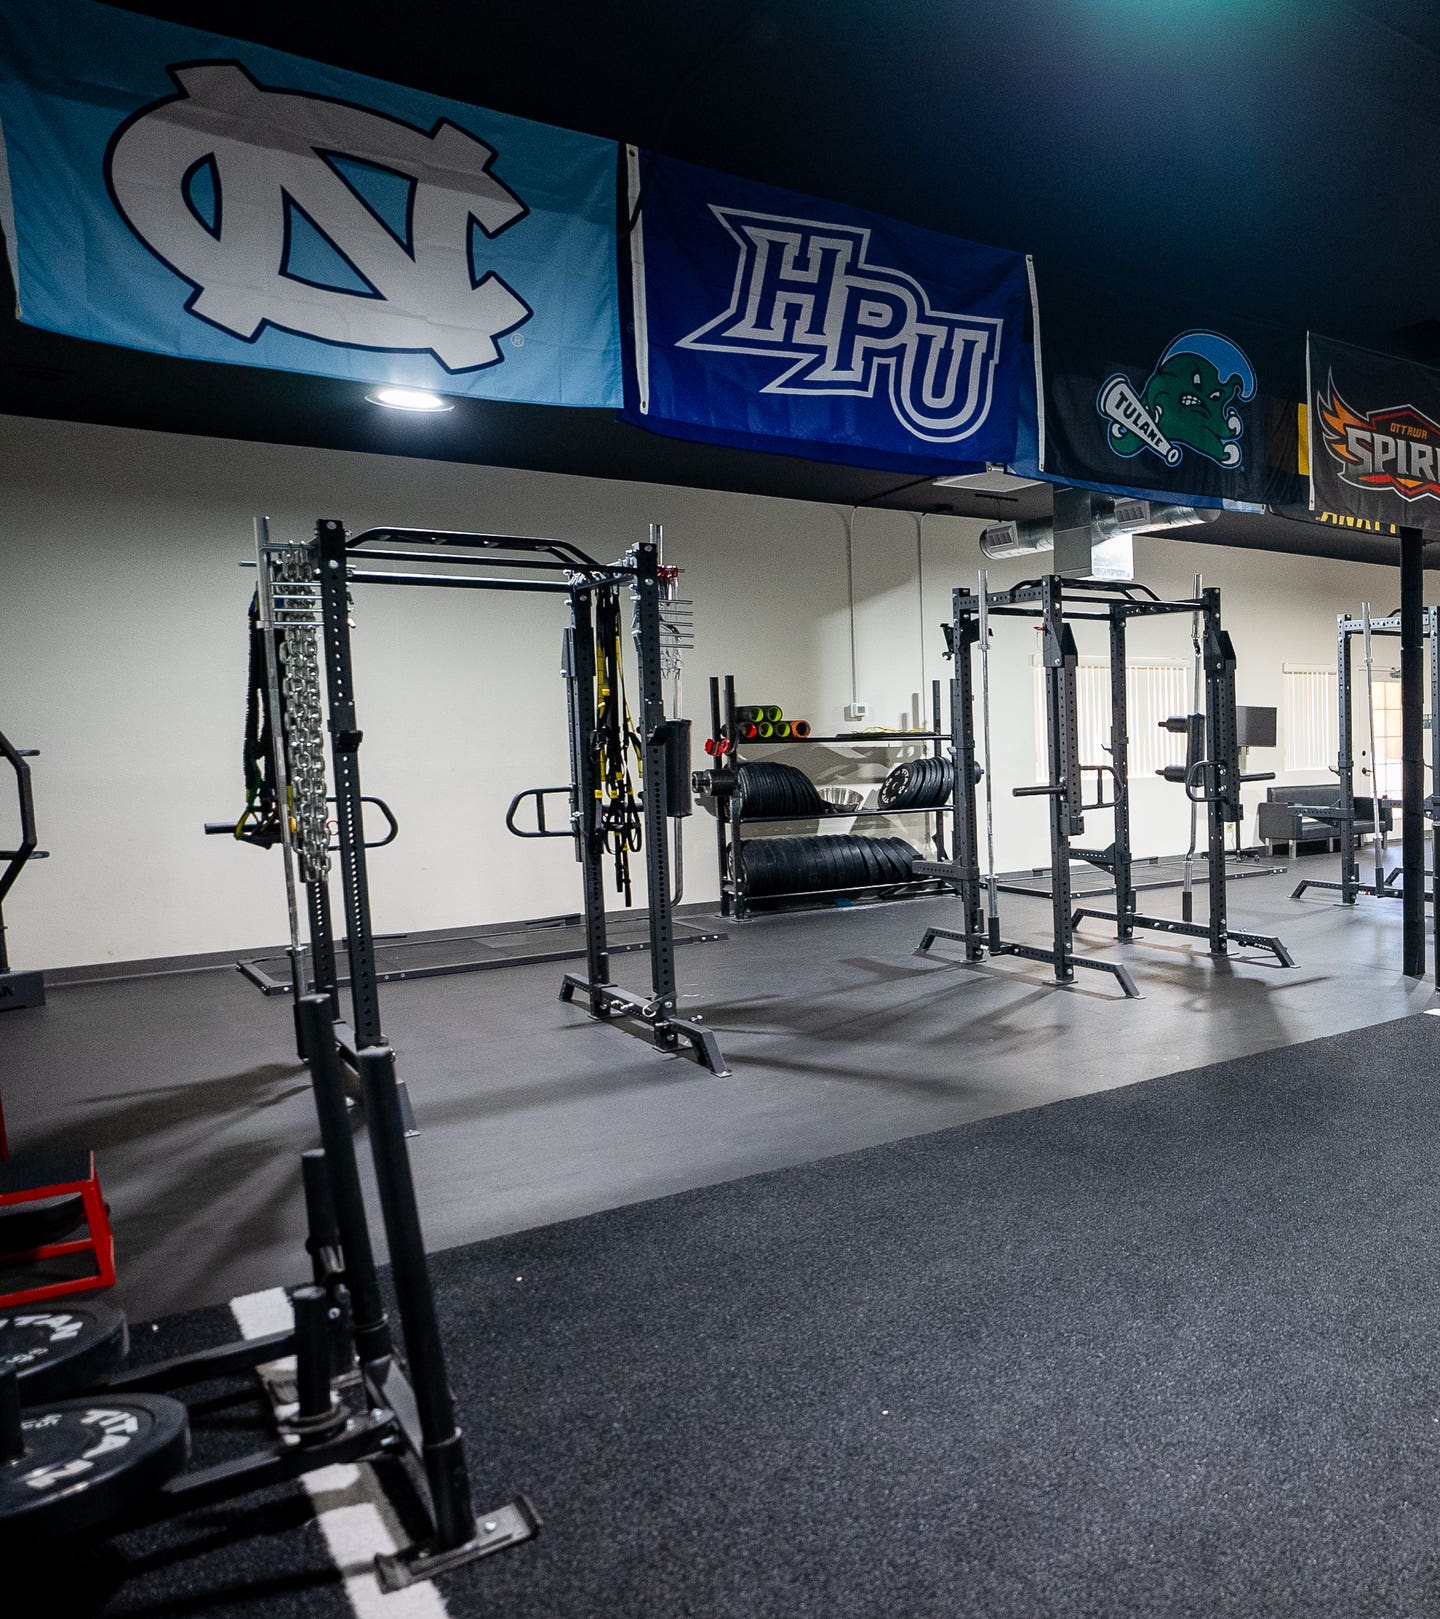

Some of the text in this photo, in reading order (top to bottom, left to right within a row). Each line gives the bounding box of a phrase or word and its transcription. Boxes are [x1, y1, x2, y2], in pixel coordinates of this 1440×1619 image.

[712, 216, 994, 436] HPU
[1115, 391, 1162, 447] TULANE
[1390, 422, 1428, 439] OTTAWA
[25, 1409, 138, 1489] TITAN
